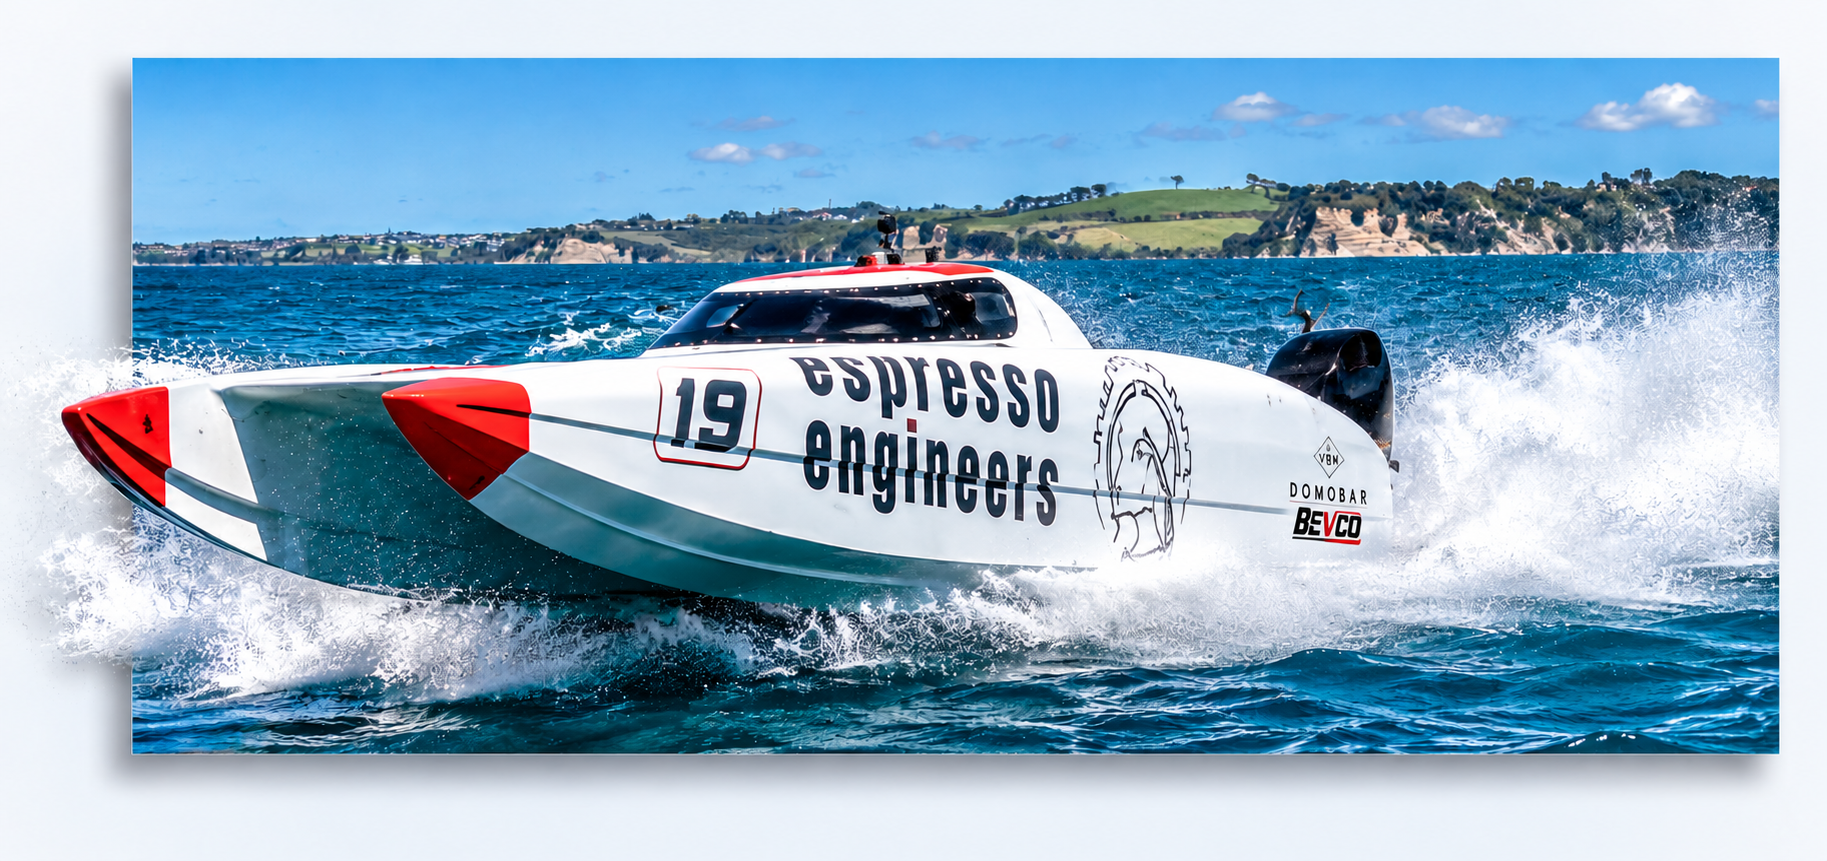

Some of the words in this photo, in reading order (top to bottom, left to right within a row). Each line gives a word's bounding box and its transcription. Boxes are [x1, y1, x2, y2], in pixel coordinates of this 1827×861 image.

[671, 378, 747, 451] 19
[792, 357, 1059, 433] espresso
[804, 419, 1059, 526] engineers
[1289, 481, 1368, 505] DOMOBAR
[1293, 507, 1362, 538] BEVCO
